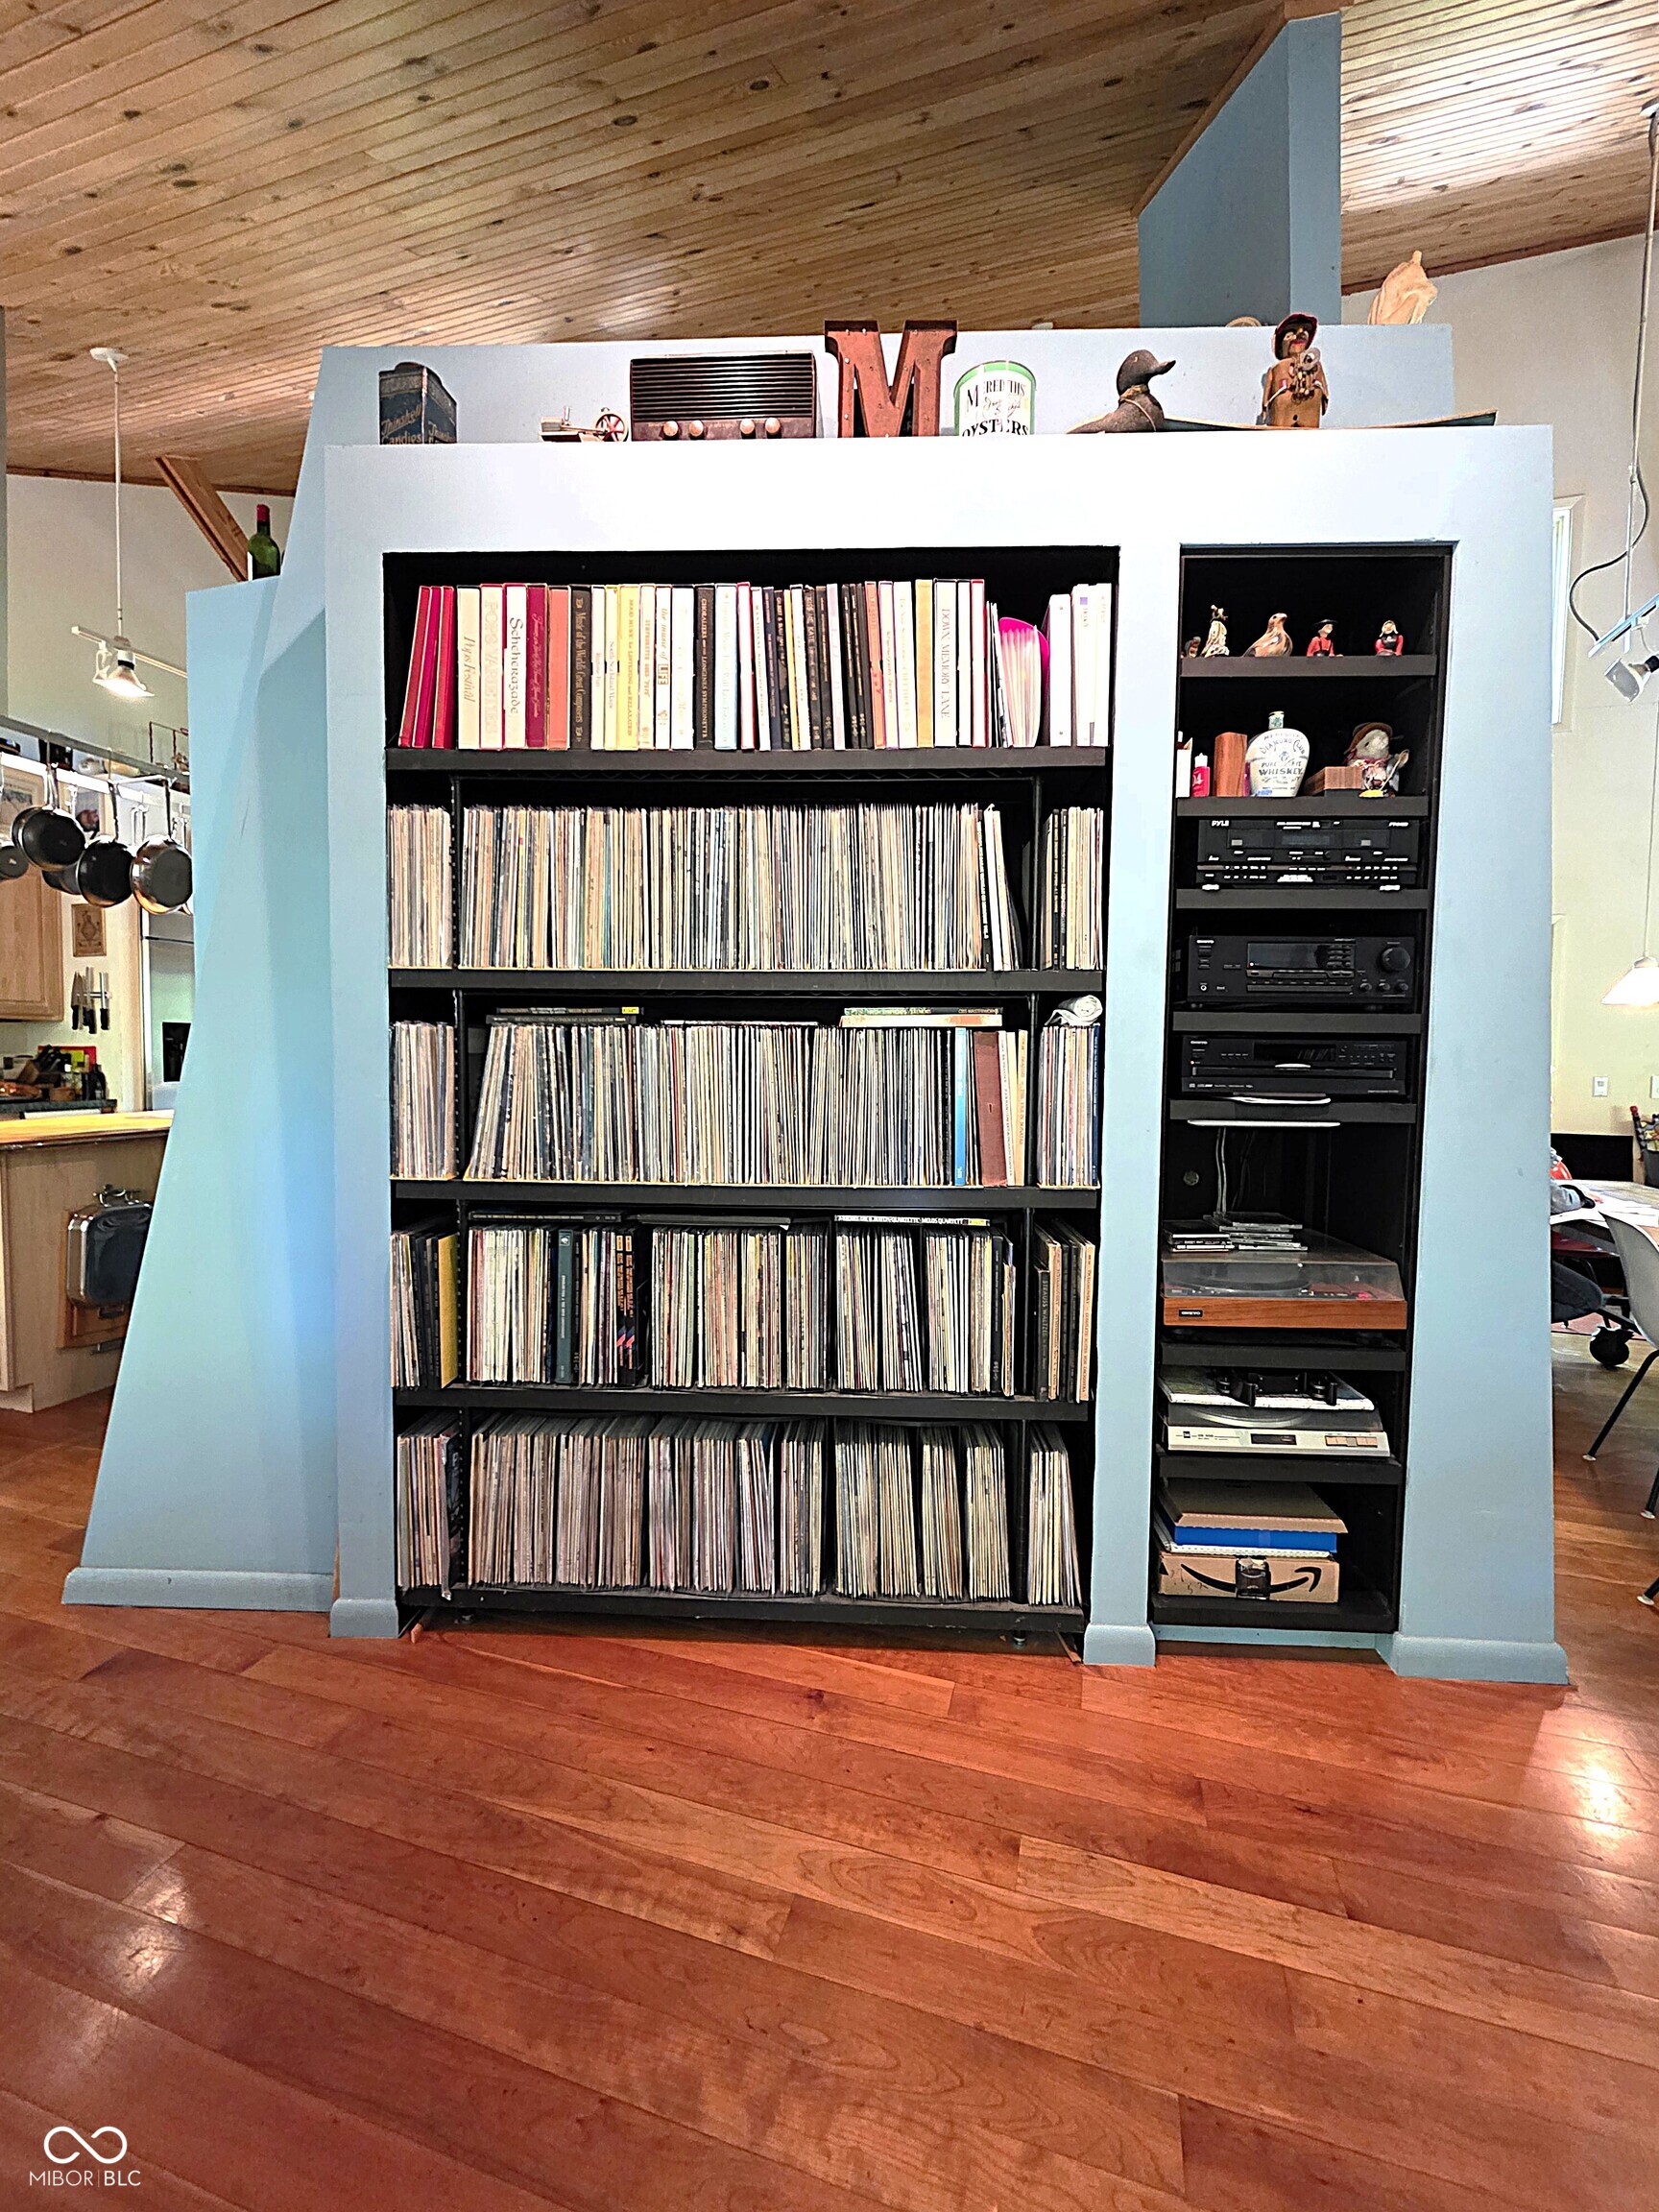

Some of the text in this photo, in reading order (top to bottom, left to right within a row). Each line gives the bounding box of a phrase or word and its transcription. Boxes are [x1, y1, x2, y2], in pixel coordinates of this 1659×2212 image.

[824, 320, 958, 437] M
[575, 612, 587, 630] Music
[509, 617, 524, 714] Scheherazade
[660, 651, 668, 661] of
[940, 609, 950, 718] DOWN MEMORY LANE
[658, 663, 669, 685] LIFE
[573, 688, 587, 723] Composers
